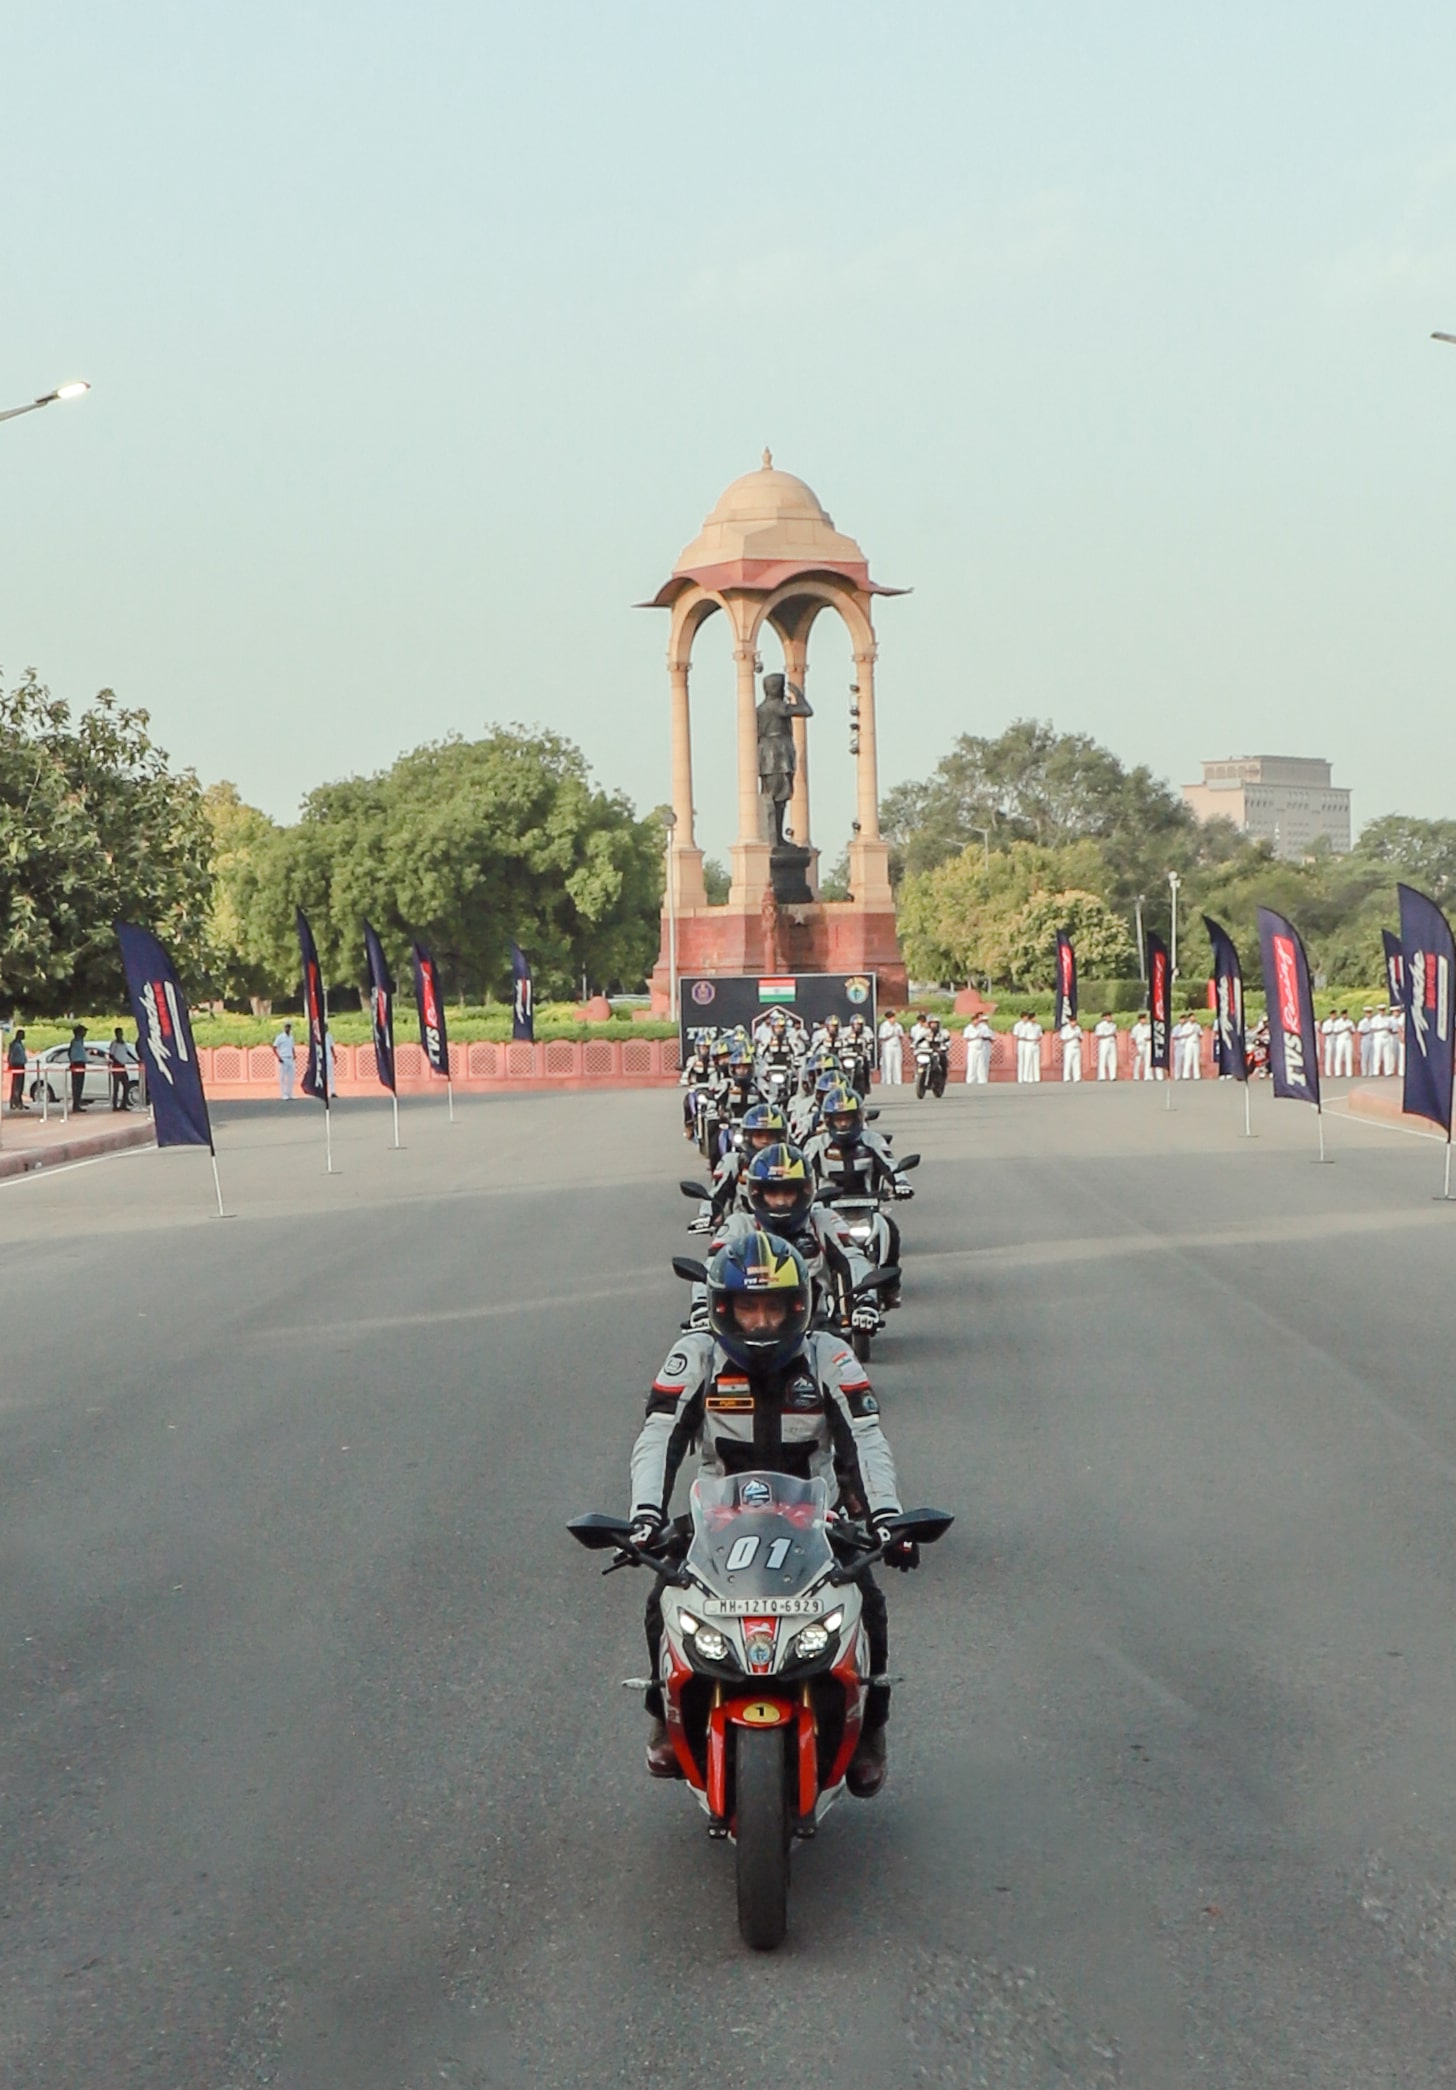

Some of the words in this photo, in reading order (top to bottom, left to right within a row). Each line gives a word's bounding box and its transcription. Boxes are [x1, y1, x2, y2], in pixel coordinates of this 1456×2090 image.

[1278, 939, 1297, 1031] Racing
[1408, 949, 1430, 1057] Apache
[139, 981, 173, 1085] Apache
[426, 1027, 440, 1064] TVS
[1154, 1021, 1165, 1058] TVS
[1284, 1032, 1306, 1087] TVS
[726, 1535, 792, 1570] 01
[755, 1706, 765, 1716] 1
